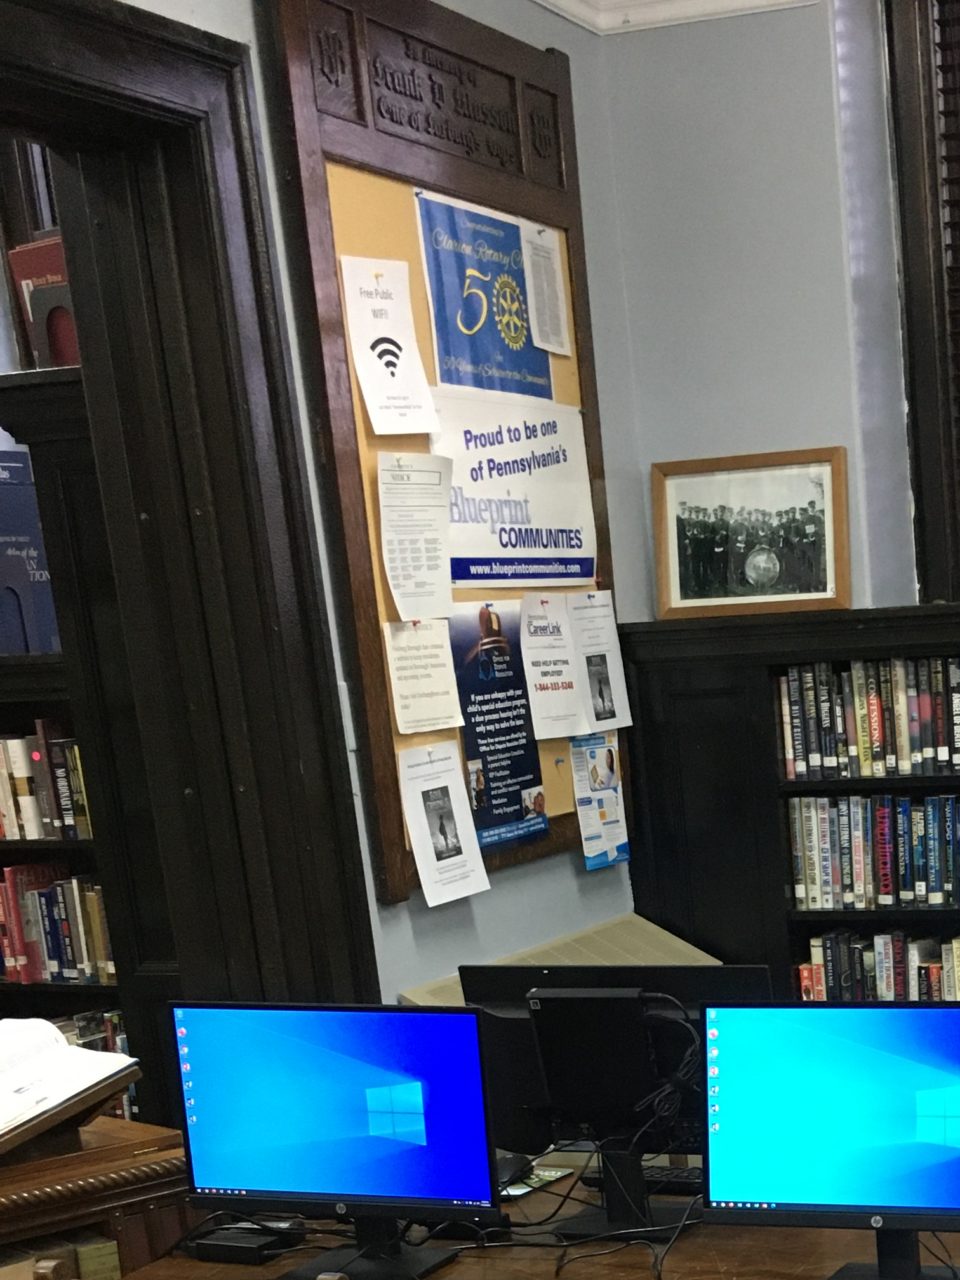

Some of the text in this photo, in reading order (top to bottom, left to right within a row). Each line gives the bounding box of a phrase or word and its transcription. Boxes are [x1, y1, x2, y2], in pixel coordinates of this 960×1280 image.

[359, 287, 373, 300] Free
[463, 418, 558, 450] Proud to be one
[470, 445, 568, 482] of Pennsylvania's
[451, 486, 531, 533] Blueprint
[499, 527, 583, 549] COMMUNITIES
[470, 562, 581, 578] www.blueprintcommunities.com
[476, 694, 484, 702] you
[515, 689, 523, 697] your
[868, 678, 880, 754] CONFESSIONAL
[55, 768, 72, 809] NO ORDINARY
[838, 801, 850, 848] TONY HILLERMAN
[926, 804, 934, 839] MYSTERY
[945, 818, 953, 841] HOAG
[897, 837, 905, 875] DARKNESS
[928, 840, 934, 849] BY
